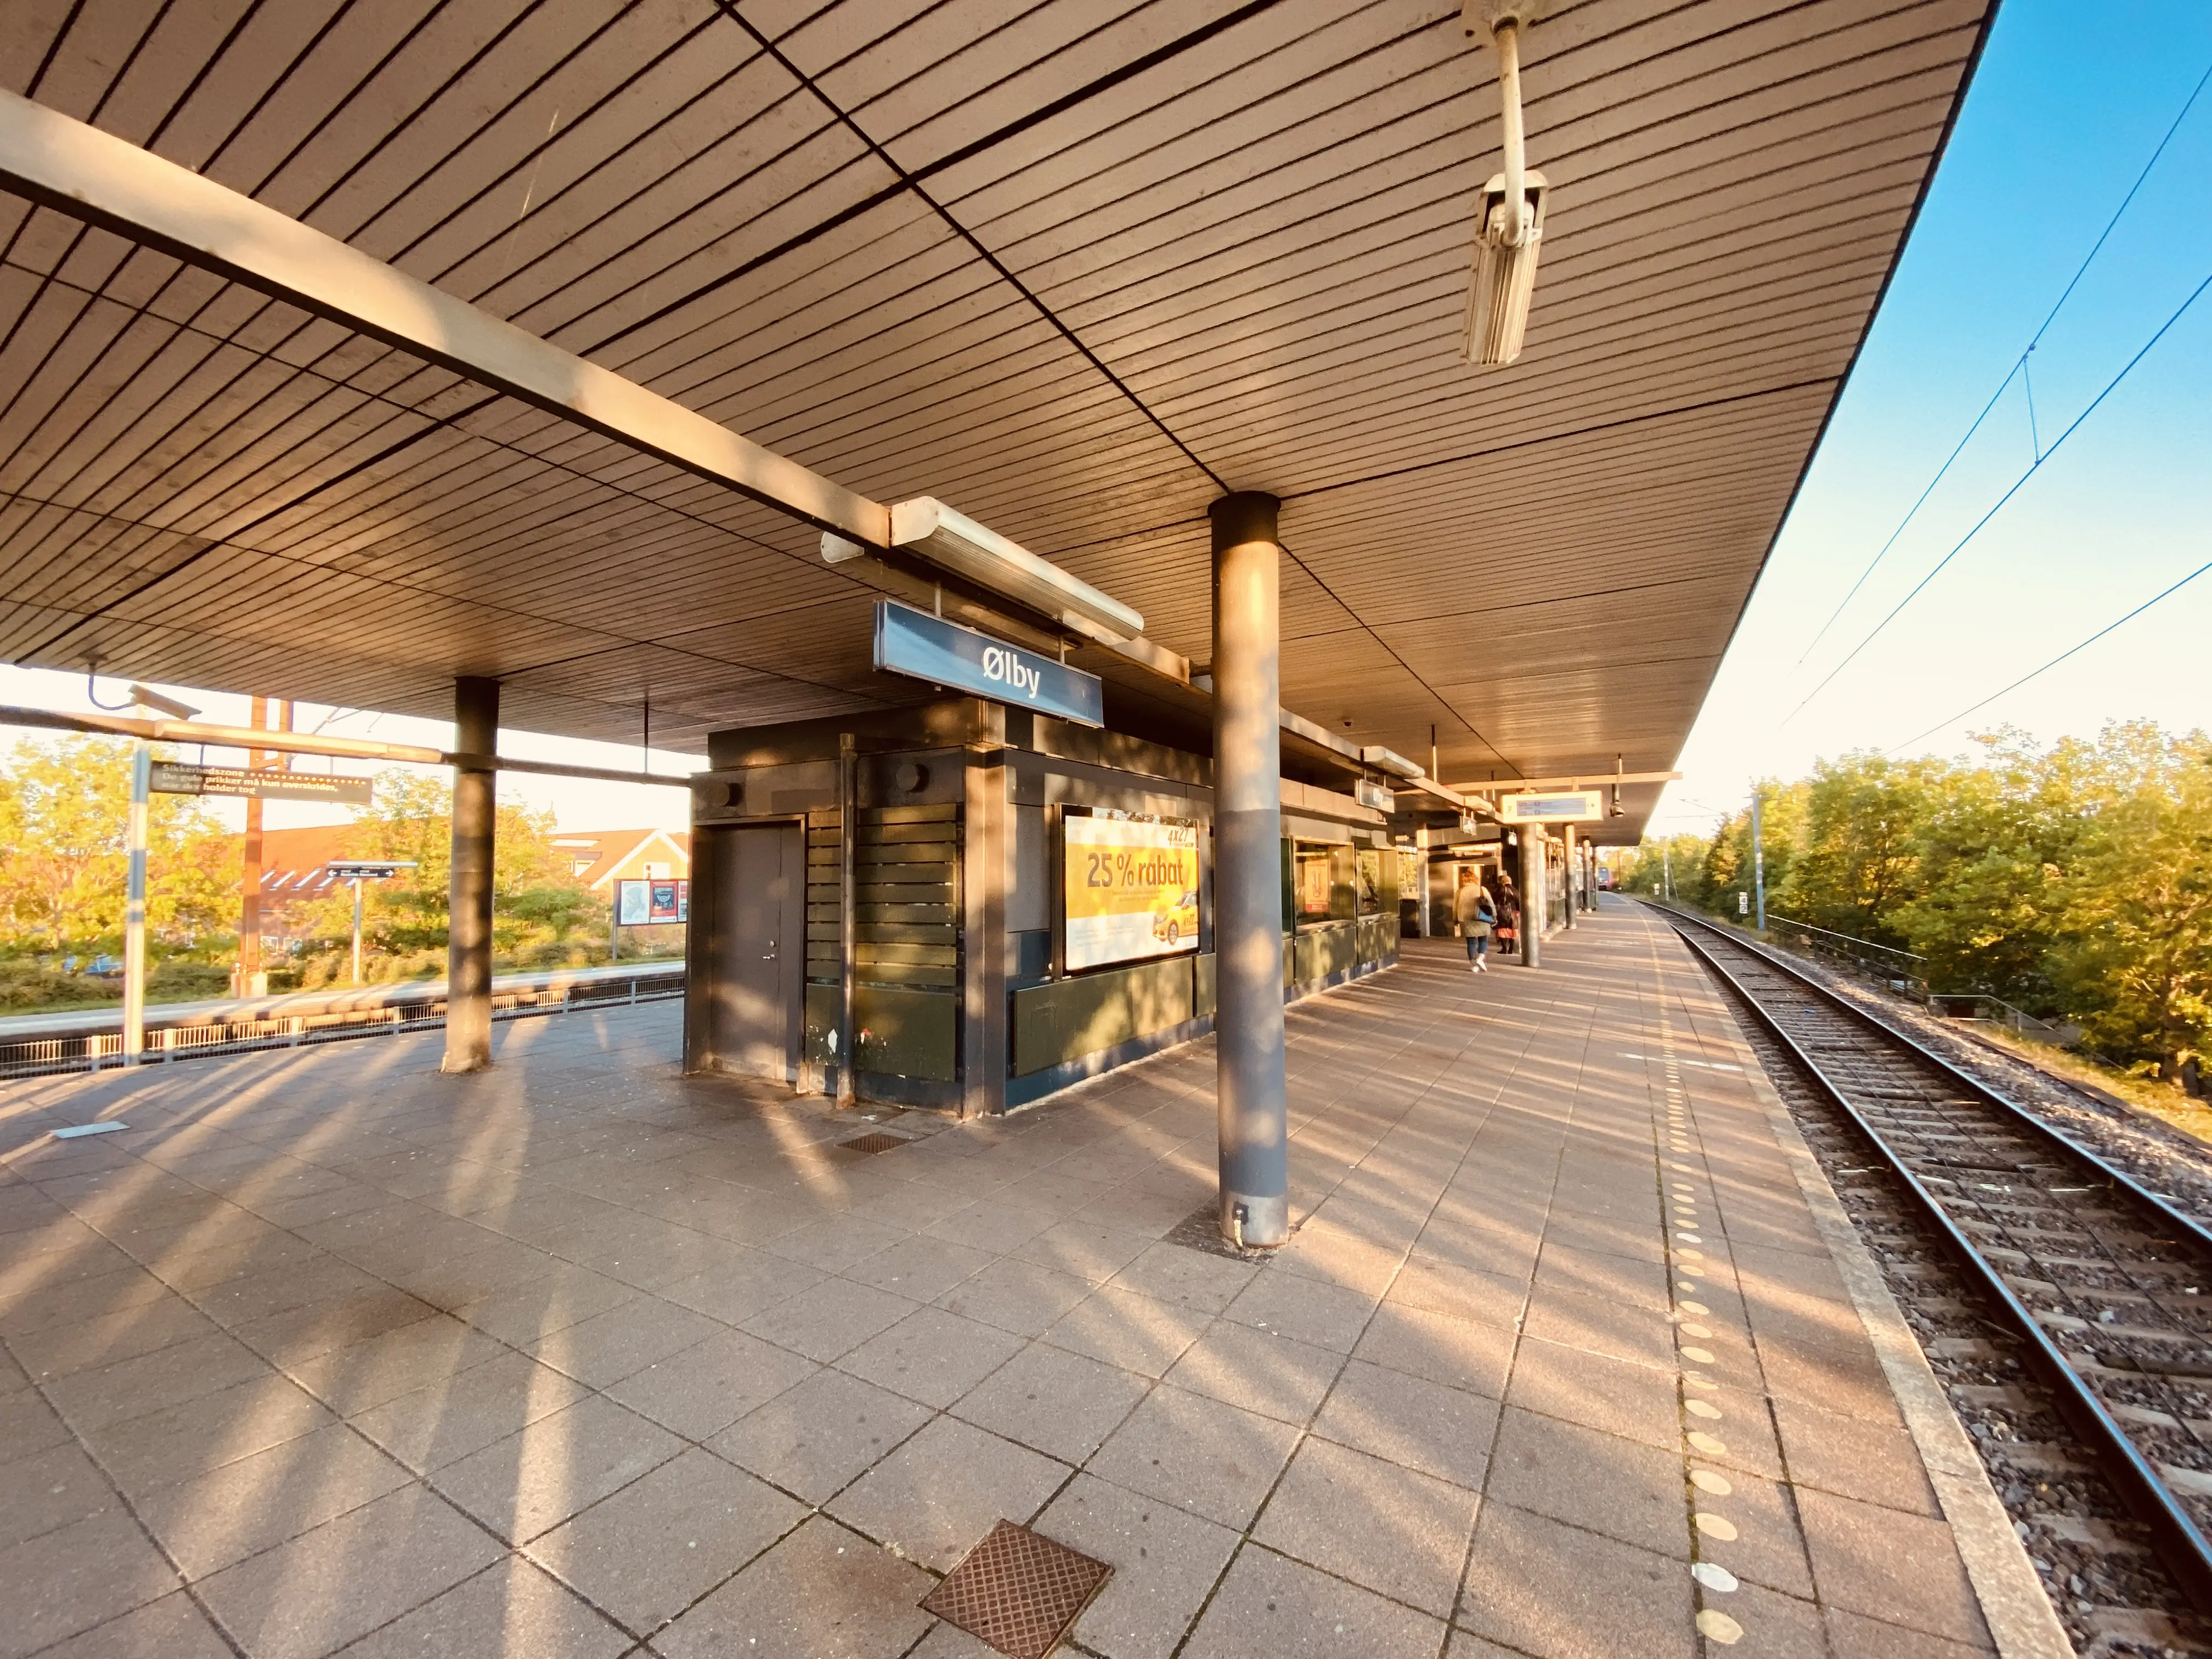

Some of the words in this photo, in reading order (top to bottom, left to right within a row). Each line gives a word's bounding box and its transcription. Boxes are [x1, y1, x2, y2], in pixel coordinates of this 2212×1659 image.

[983, 647, 1040, 698] Ølby
[163, 764, 245, 777] Sikkerhedszone
[205, 776, 242, 785] prikker
[262, 779, 280, 787] kun
[203, 783, 236, 792] holder
[239, 786, 256, 795] tog
[1087, 853, 1113, 887] 25
[1117, 854, 1134, 886] %
[1138, 855, 1183, 886] rabat
